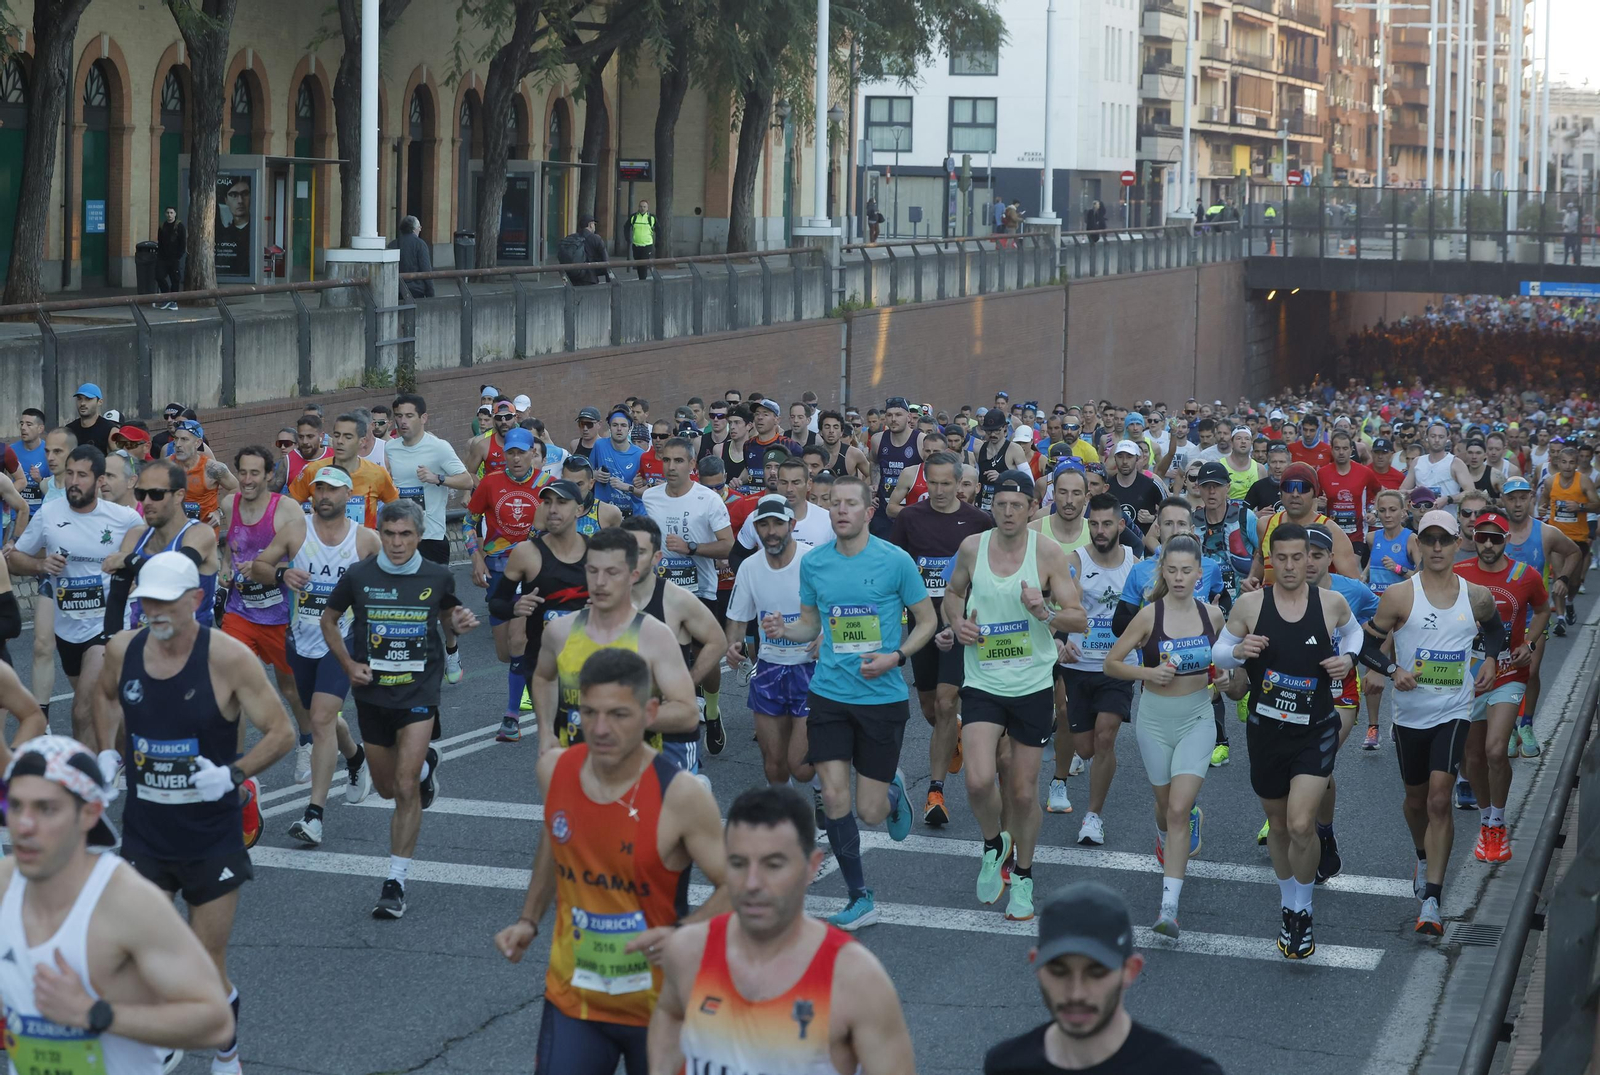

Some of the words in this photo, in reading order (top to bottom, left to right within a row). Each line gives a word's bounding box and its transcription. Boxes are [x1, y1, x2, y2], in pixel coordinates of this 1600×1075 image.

[70, 578, 97, 586] ZURICH
[62, 598, 101, 610] ANTONIO
[367, 608, 429, 620] BARCELONA
[844, 607, 872, 615] ZURICH
[845, 621, 862, 629] 2068
[993, 623, 1022, 633] ZURICH
[390, 627, 419, 635] ZURICH
[843, 631, 867, 641] PAUL
[389, 641, 406, 649] 4263
[1176, 638, 1204, 648] ZURICH
[384, 650, 411, 661] JOSE
[986, 646, 1024, 659] JEROEN
[1282, 677, 1312, 688] ZURICH
[1434, 678, 1463, 686] CABRERA
[1280, 690, 1297, 700] 4058
[1275, 697, 1297, 712] TITO
[151, 744, 190, 754] ZURICH
[144, 771, 188, 789] OLIVER
[582, 869, 650, 897] CAMAS
[590, 917, 637, 930] ZURICH
